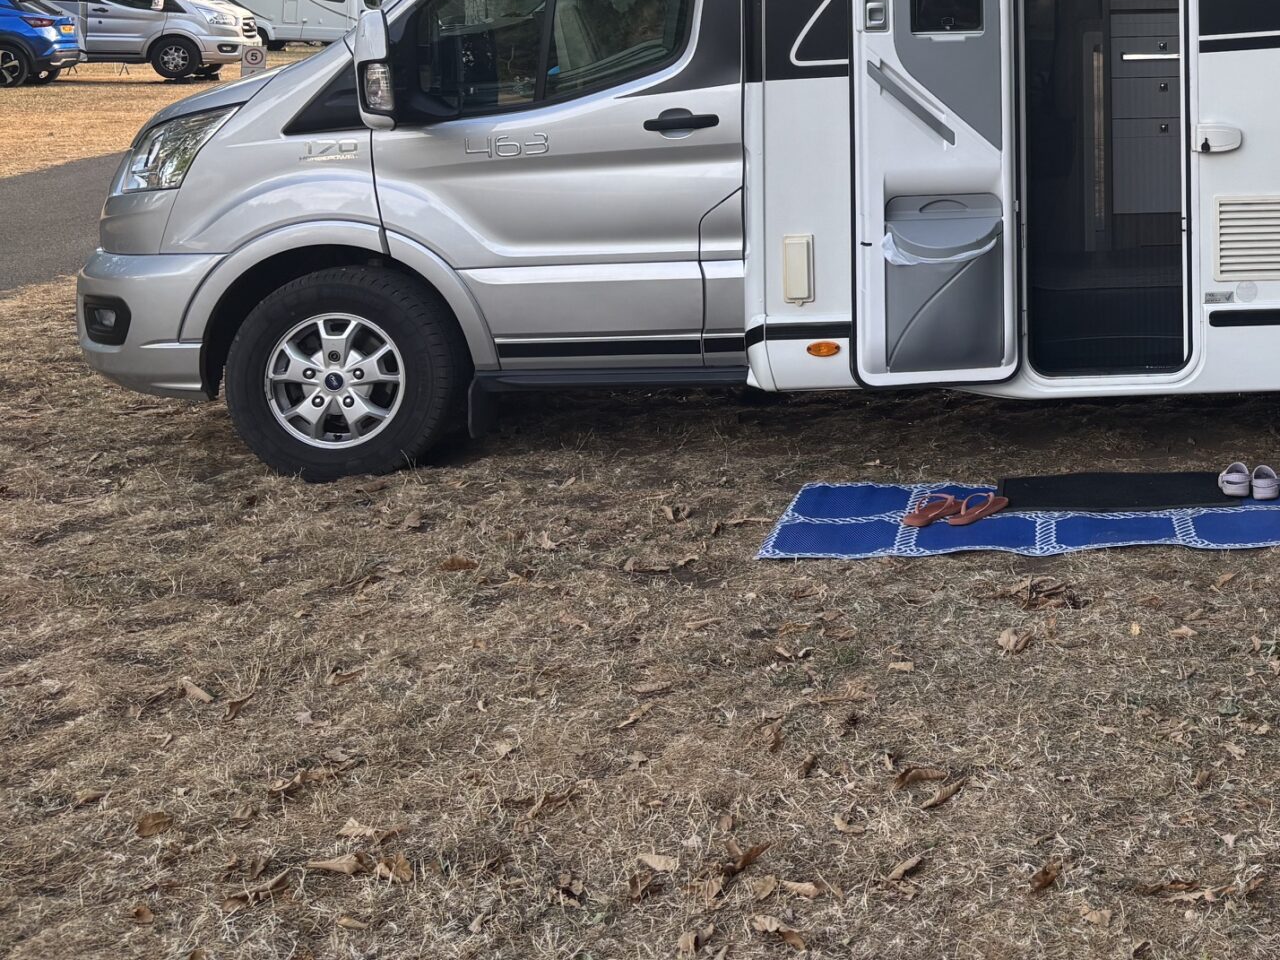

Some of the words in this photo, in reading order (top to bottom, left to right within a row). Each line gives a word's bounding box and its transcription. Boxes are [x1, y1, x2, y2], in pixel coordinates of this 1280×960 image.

[250, 52, 258, 61] 5
[303, 138, 358, 154] 170
[463, 132, 550, 158] 463
